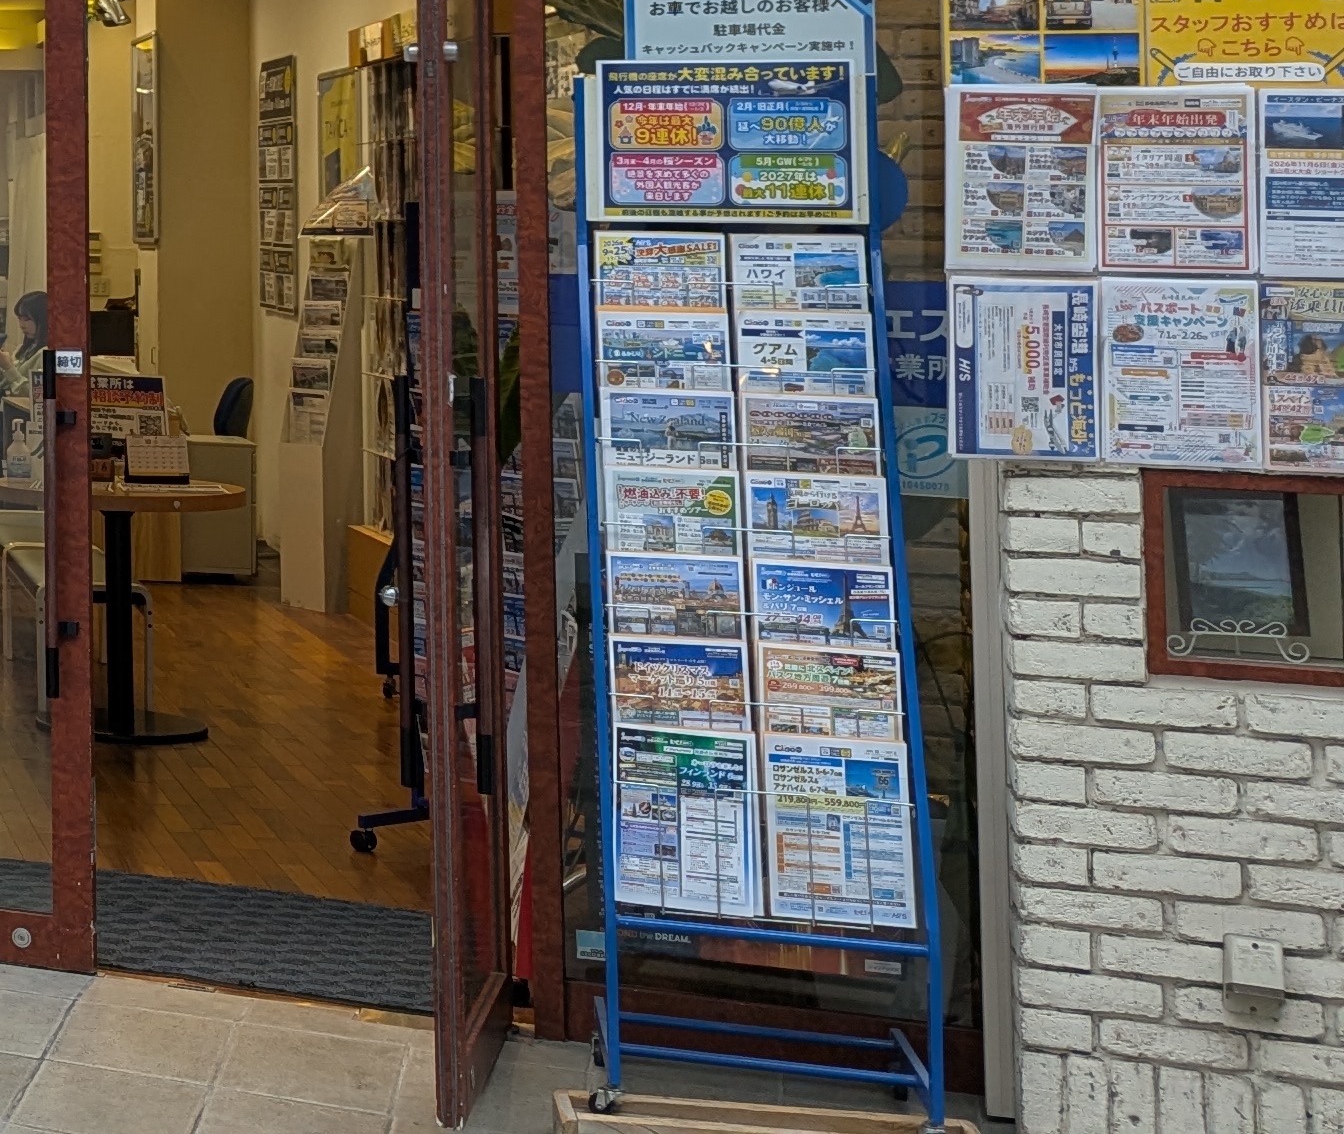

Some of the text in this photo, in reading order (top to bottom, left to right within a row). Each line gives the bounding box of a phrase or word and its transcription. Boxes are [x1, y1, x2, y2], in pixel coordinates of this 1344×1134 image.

[713, 22, 786, 38] 駐車場代金
[1221, 38, 1283, 58] こちら
[1175, 64, 1323, 80] ご自由にお取り下さい
[1140, 302, 1202, 315] パスポート
[752, 342, 798, 357] グアム
[630, 411, 656, 425] New
